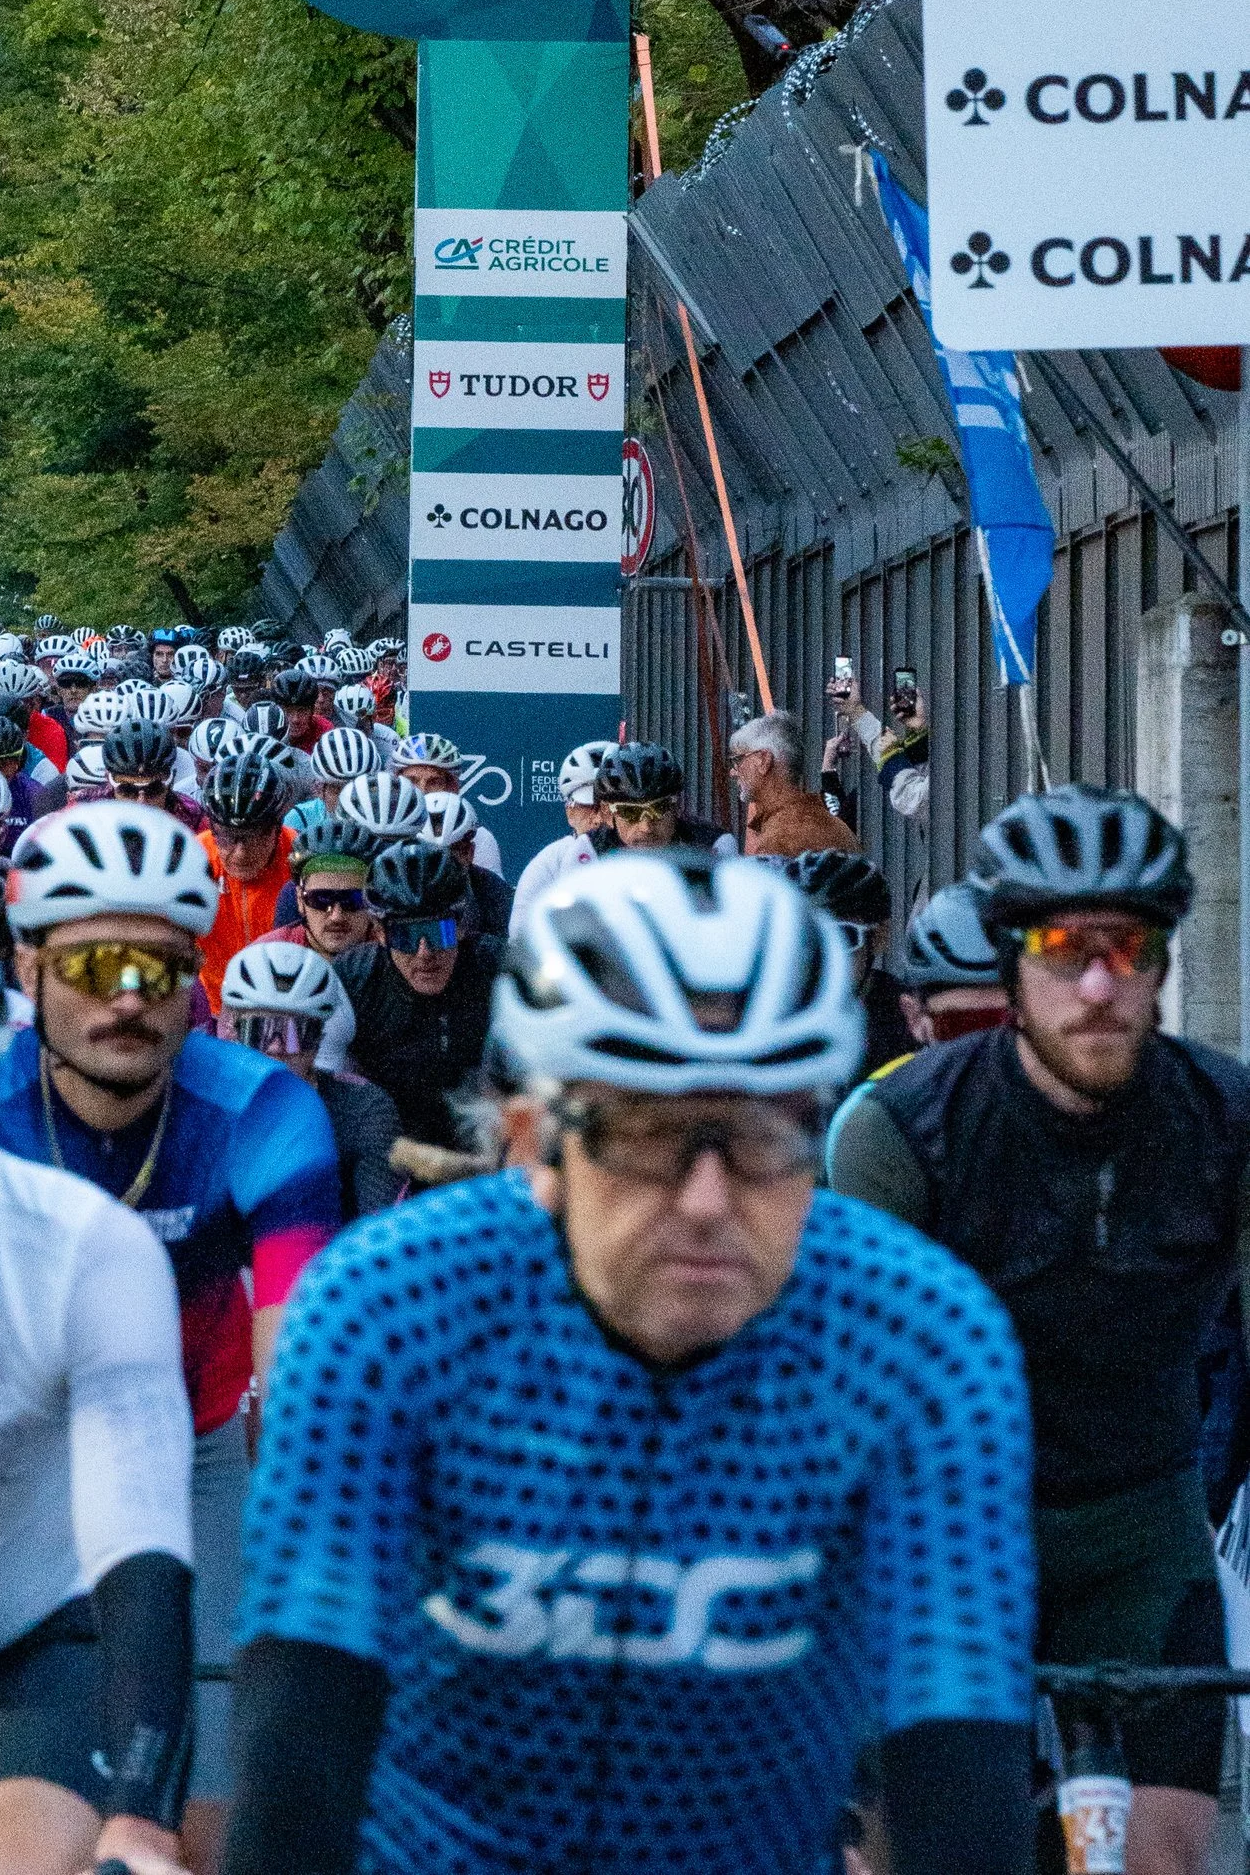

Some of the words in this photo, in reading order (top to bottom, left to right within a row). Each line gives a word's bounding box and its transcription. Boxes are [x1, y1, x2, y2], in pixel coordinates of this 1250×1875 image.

[488, 236, 576, 255] CRÉDIT
[488, 257, 609, 273] AGRICOLE
[459, 374, 579, 398] TUDOR
[459, 507, 608, 532] COLNAGO
[465, 640, 609, 659] CASTELLI
[531, 760, 555, 773] FCI
[531, 776, 559, 785] FEDE
